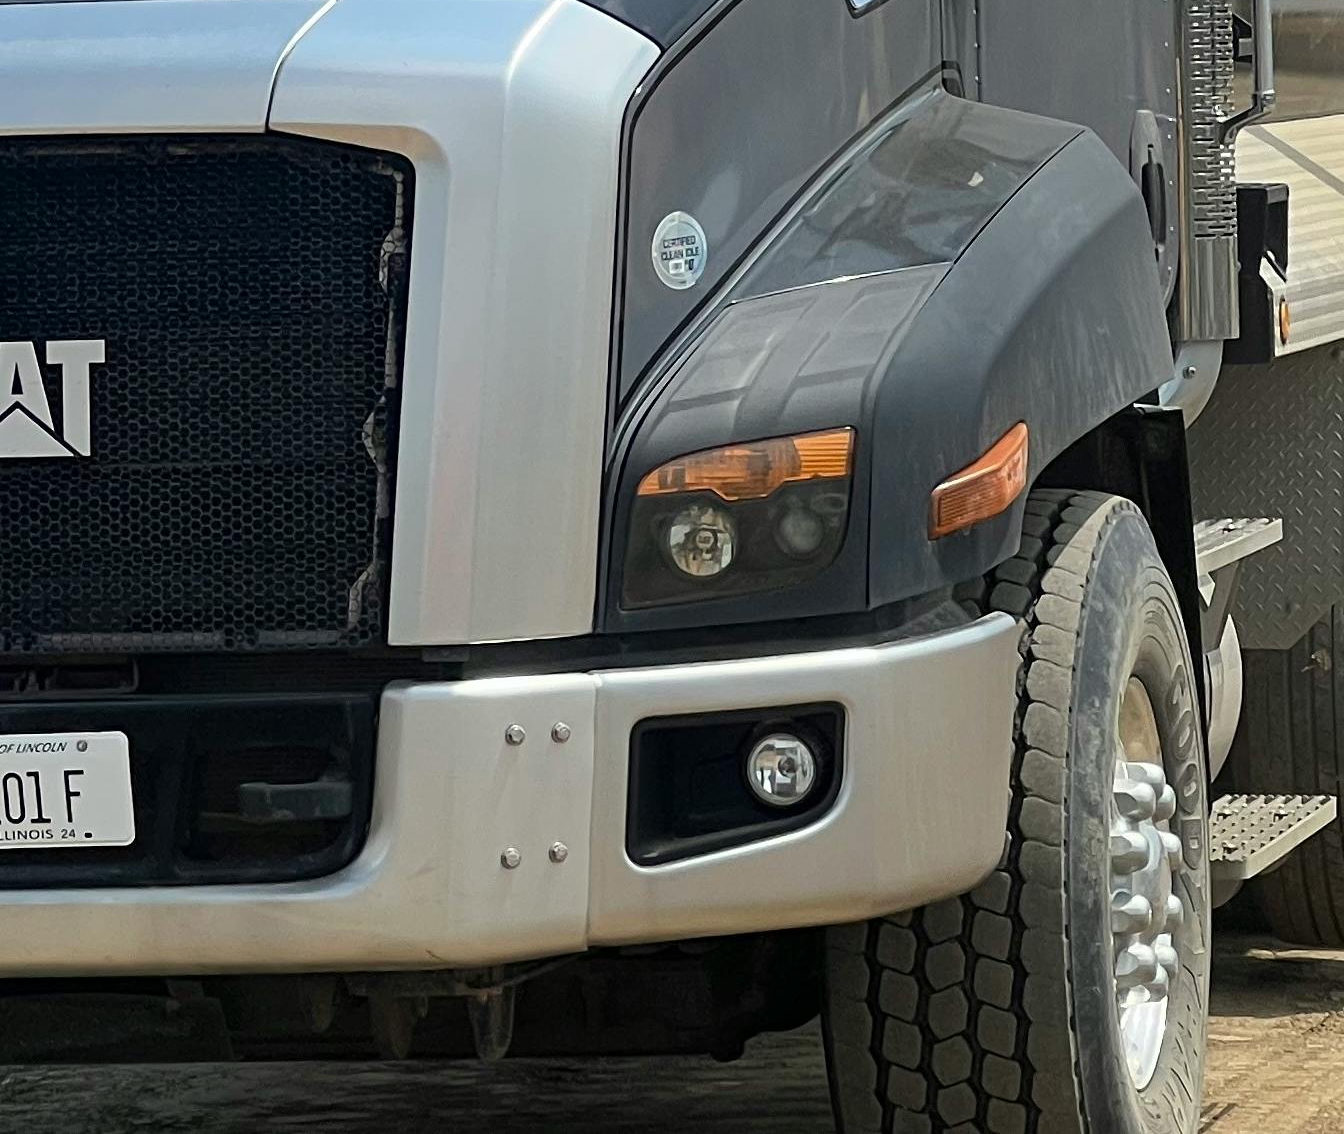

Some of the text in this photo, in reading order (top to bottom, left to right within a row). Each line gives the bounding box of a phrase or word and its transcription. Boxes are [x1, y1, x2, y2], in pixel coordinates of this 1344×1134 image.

[16, 742, 68, 754] LINCOLN
[63, 769, 85, 823] F
[60, 828, 76, 839] 24
